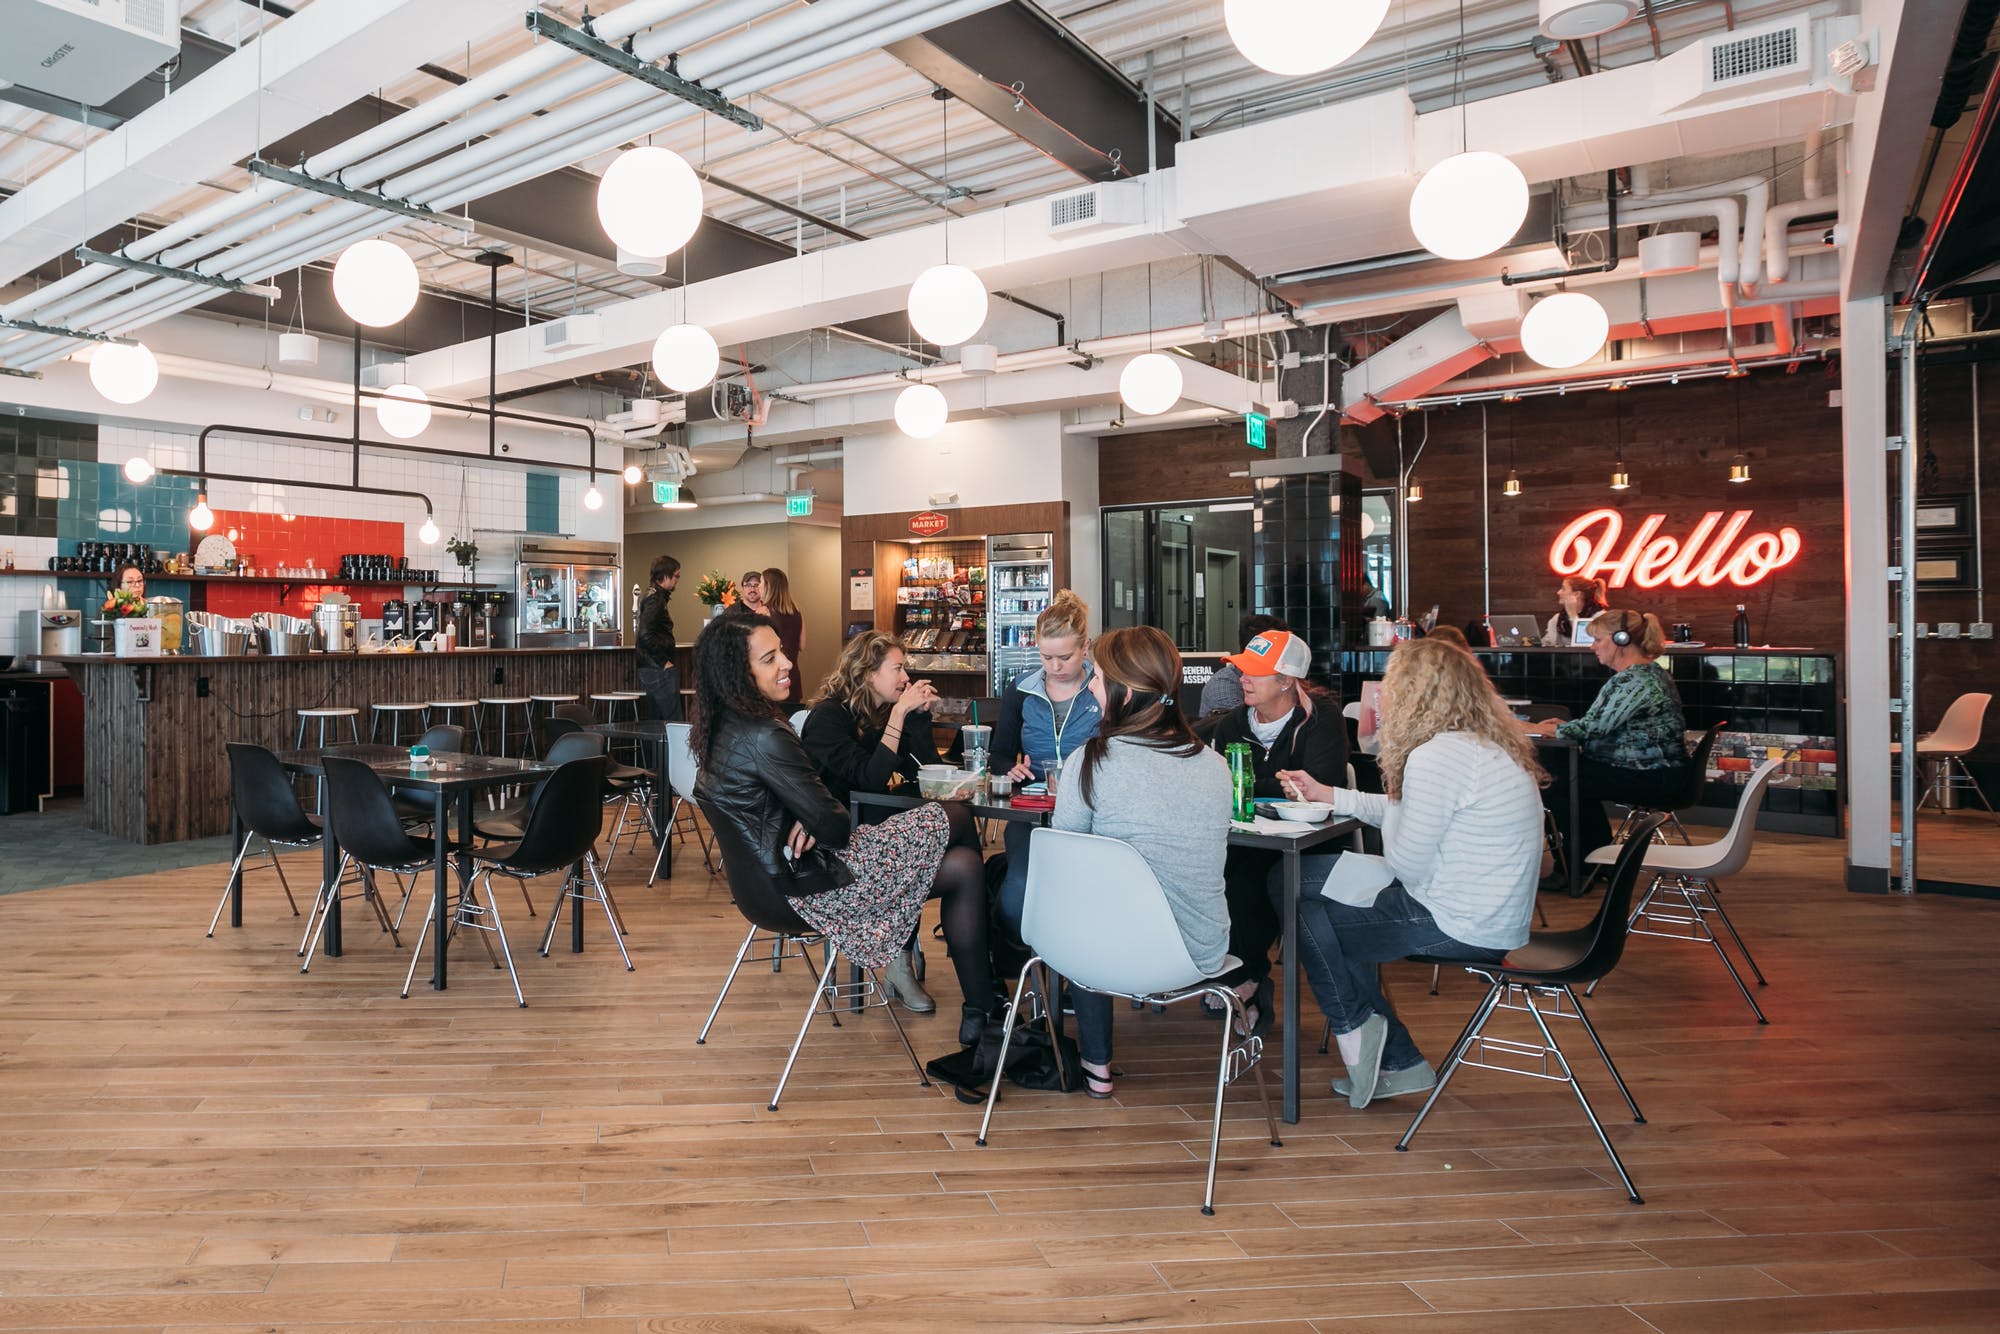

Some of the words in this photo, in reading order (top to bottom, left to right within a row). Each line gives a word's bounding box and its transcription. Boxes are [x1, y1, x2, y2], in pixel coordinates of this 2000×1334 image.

[40, 44, 75, 68] CHRISTIE
[912, 519, 945, 528] MARKET
[1549, 508, 1801, 588] Hello
[1182, 666, 1214, 675] GENERAL
[1183, 675, 1213, 684] ASSEMB
